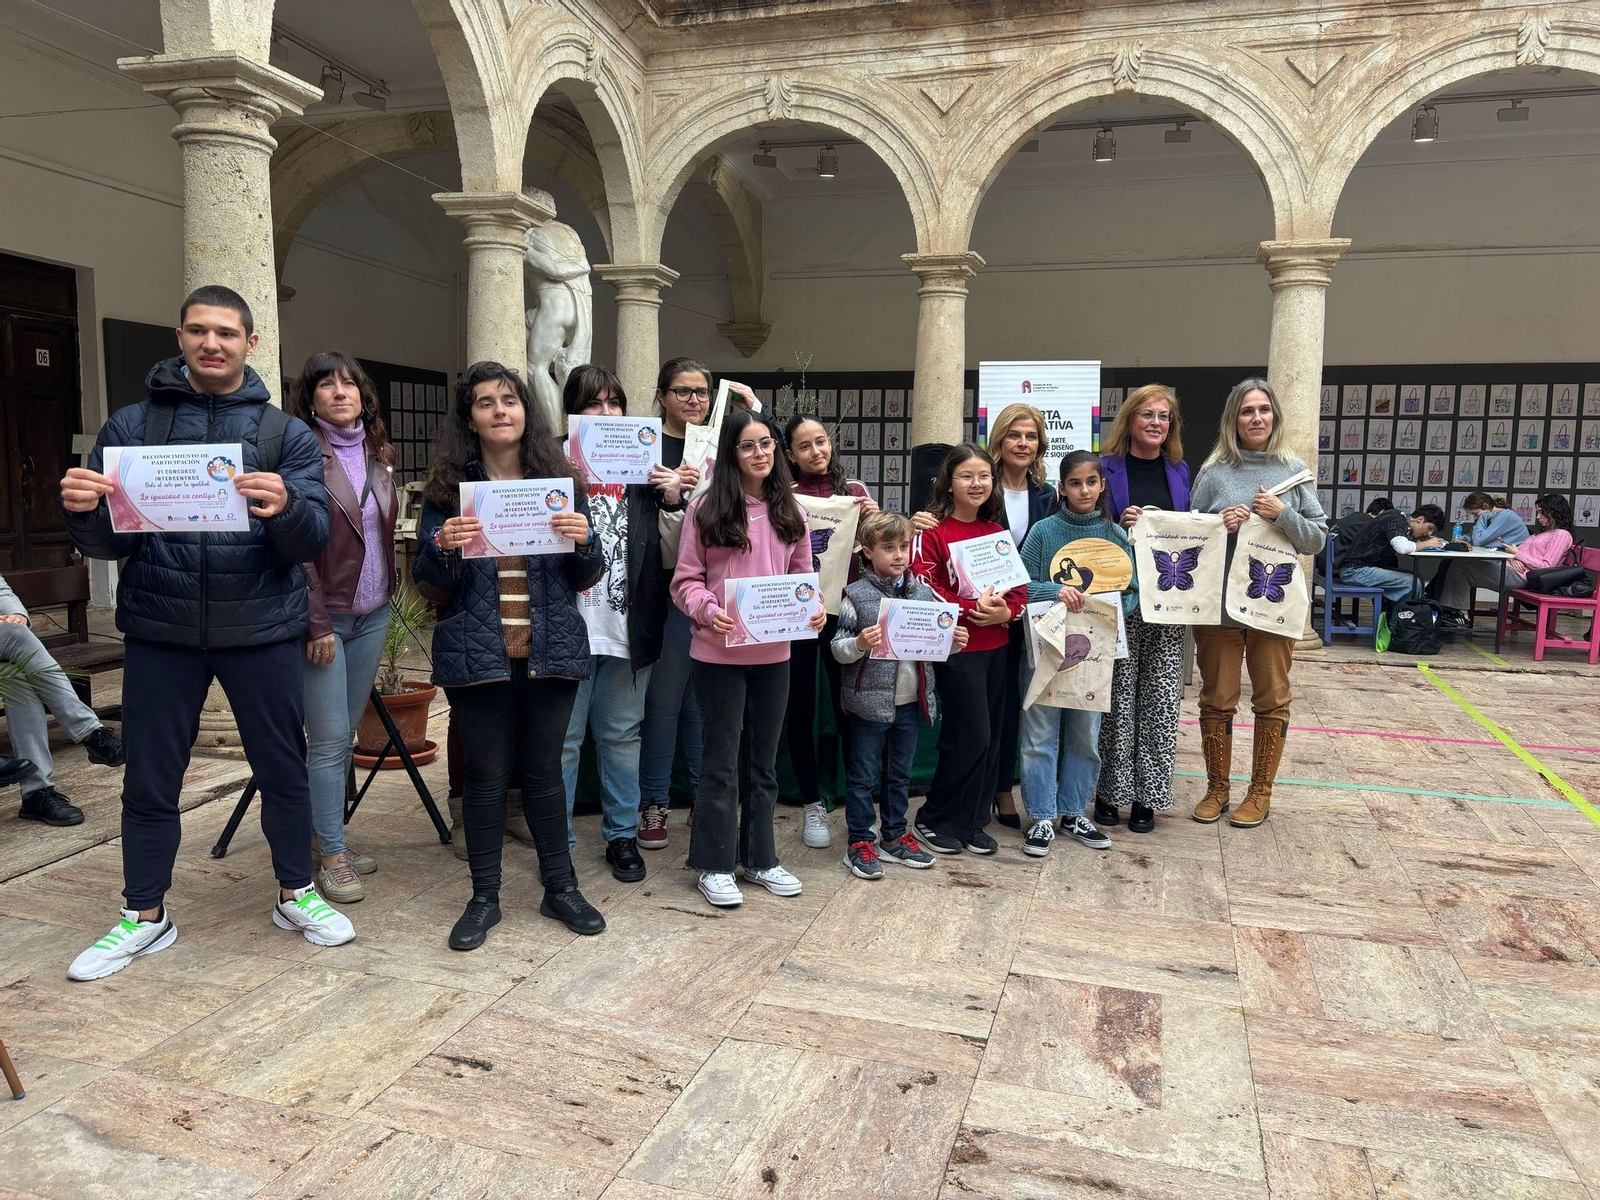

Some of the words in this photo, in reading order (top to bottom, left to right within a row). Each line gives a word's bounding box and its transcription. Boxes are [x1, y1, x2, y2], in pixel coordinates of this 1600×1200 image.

[38, 351, 48, 364] 06
[1039, 410, 1061, 420] RTA
[150, 493, 180, 501] igualdad
